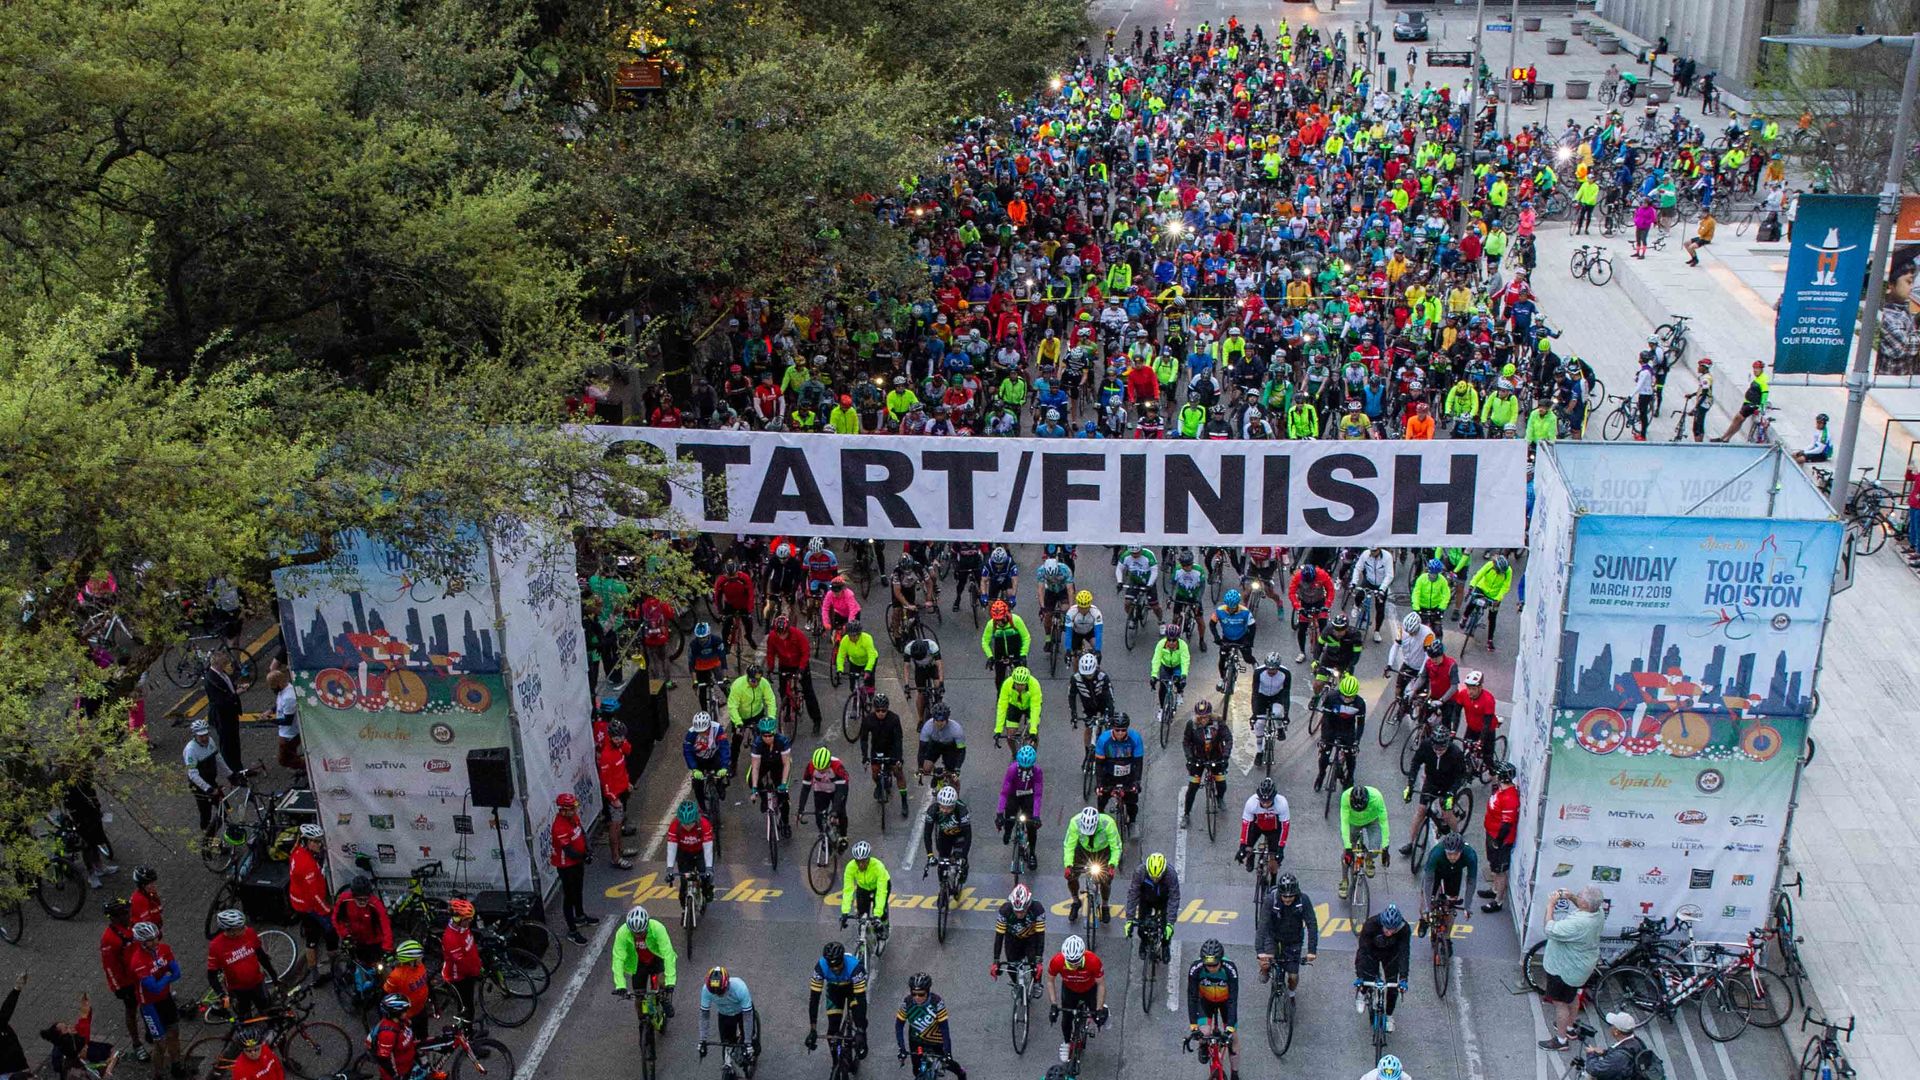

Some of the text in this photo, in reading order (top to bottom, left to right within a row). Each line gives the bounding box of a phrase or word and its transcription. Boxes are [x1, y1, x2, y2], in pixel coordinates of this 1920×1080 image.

[1798, 316, 1838, 325] OUR CITY.
[1790, 327, 1841, 335] OUR RODEO.
[1782, 337, 1846, 346] OUR TRADITION.
[1592, 554, 1677, 581] SUNDAY
[1707, 560, 1795, 584] TOUR de
[1590, 582, 1672, 600] MARCH 17, 2019
[1704, 584, 1802, 608] HOUSTON
[1613, 599, 1634, 607] FOR
[1635, 601, 1671, 609] TREES!
[365, 760, 406, 770] MOTIVA
[1609, 768, 1672, 791] Apache
[1608, 810, 1655, 820] MOTIVA
[1671, 841, 1705, 850] ULTRA
